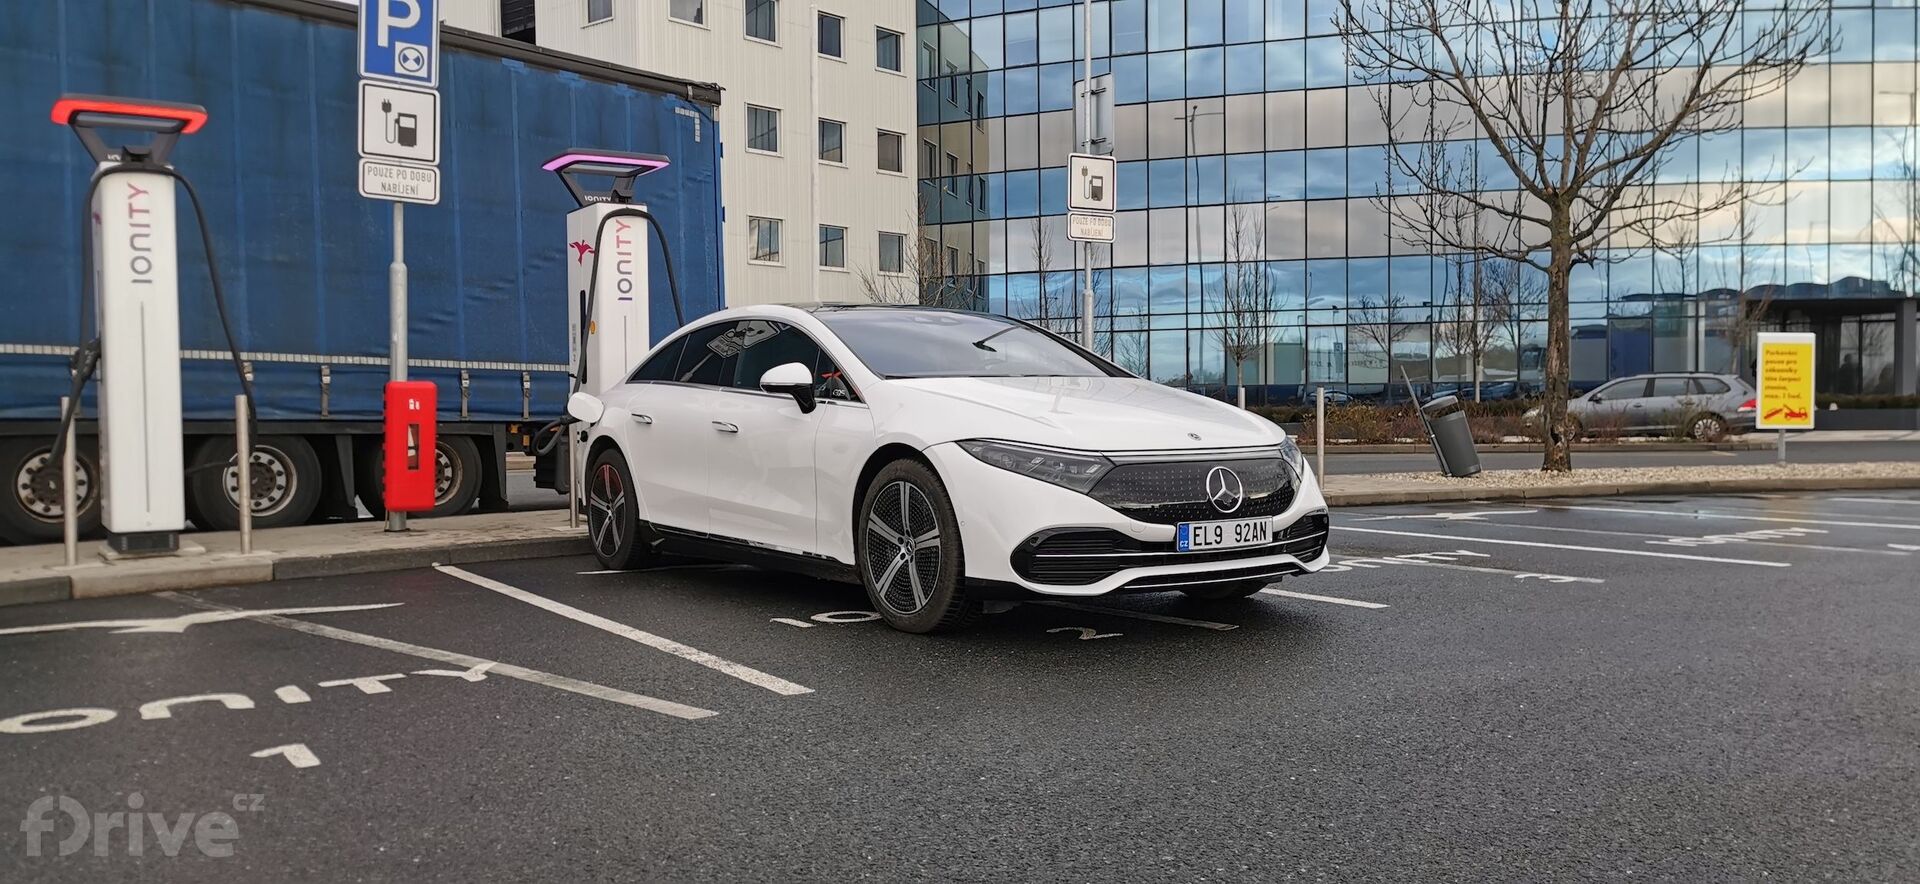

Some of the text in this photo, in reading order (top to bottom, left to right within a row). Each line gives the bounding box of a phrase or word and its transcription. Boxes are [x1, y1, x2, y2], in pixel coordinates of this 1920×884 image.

[378, 0, 421, 47] P
[367, 165, 432, 183] POUZE PO DOBU
[380, 181, 419, 195] NABÍJENÍ
[615, 218, 633, 301] IONITY
[1180, 521, 1267, 548] CZ EL9 92AN
[250, 743, 322, 769] 1
